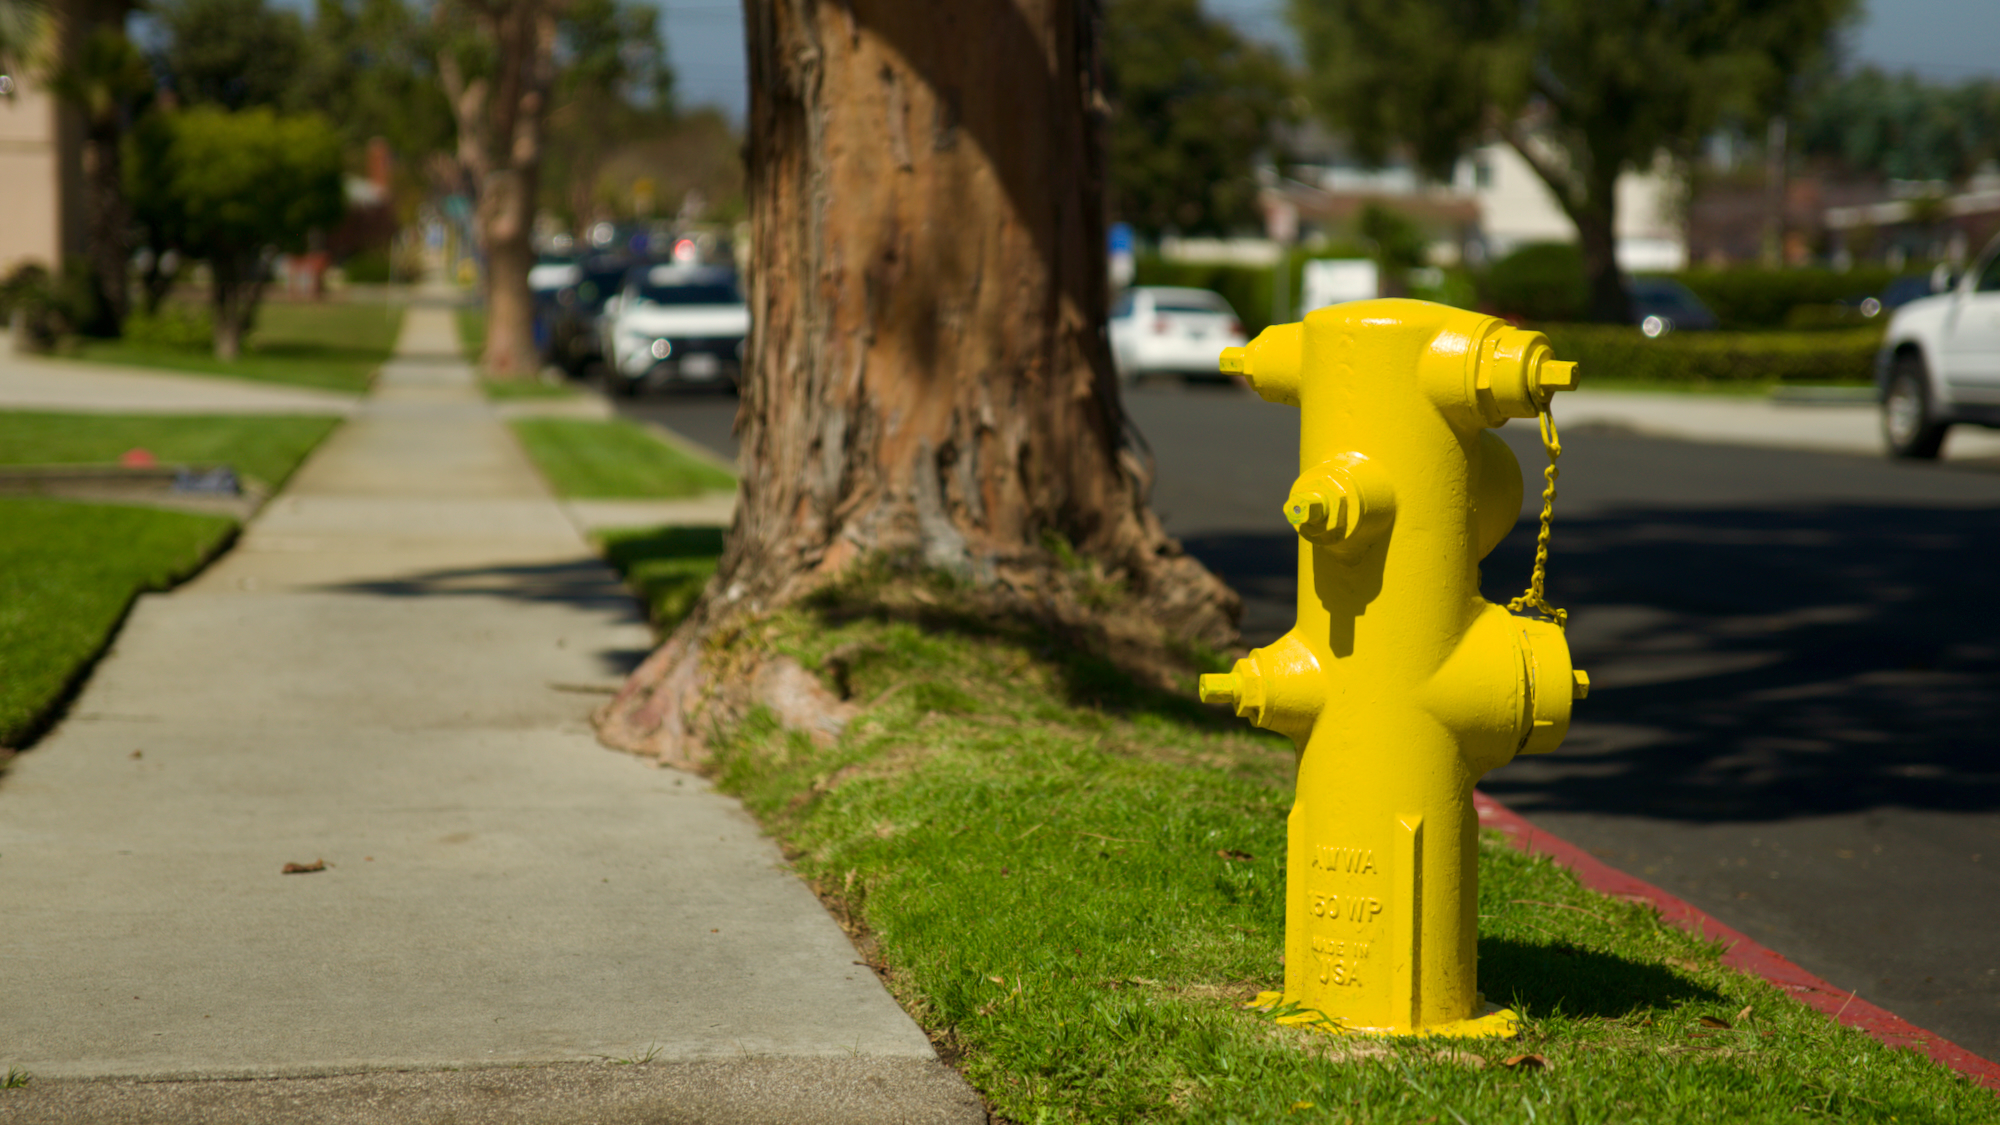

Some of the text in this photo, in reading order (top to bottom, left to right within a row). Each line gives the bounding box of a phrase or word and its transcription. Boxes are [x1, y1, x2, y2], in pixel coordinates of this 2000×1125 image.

[1311, 843, 1378, 875] AWWA
[1345, 895, 1384, 924] WP
[1353, 941, 1370, 959] IN
[1318, 956, 1363, 988] USA
